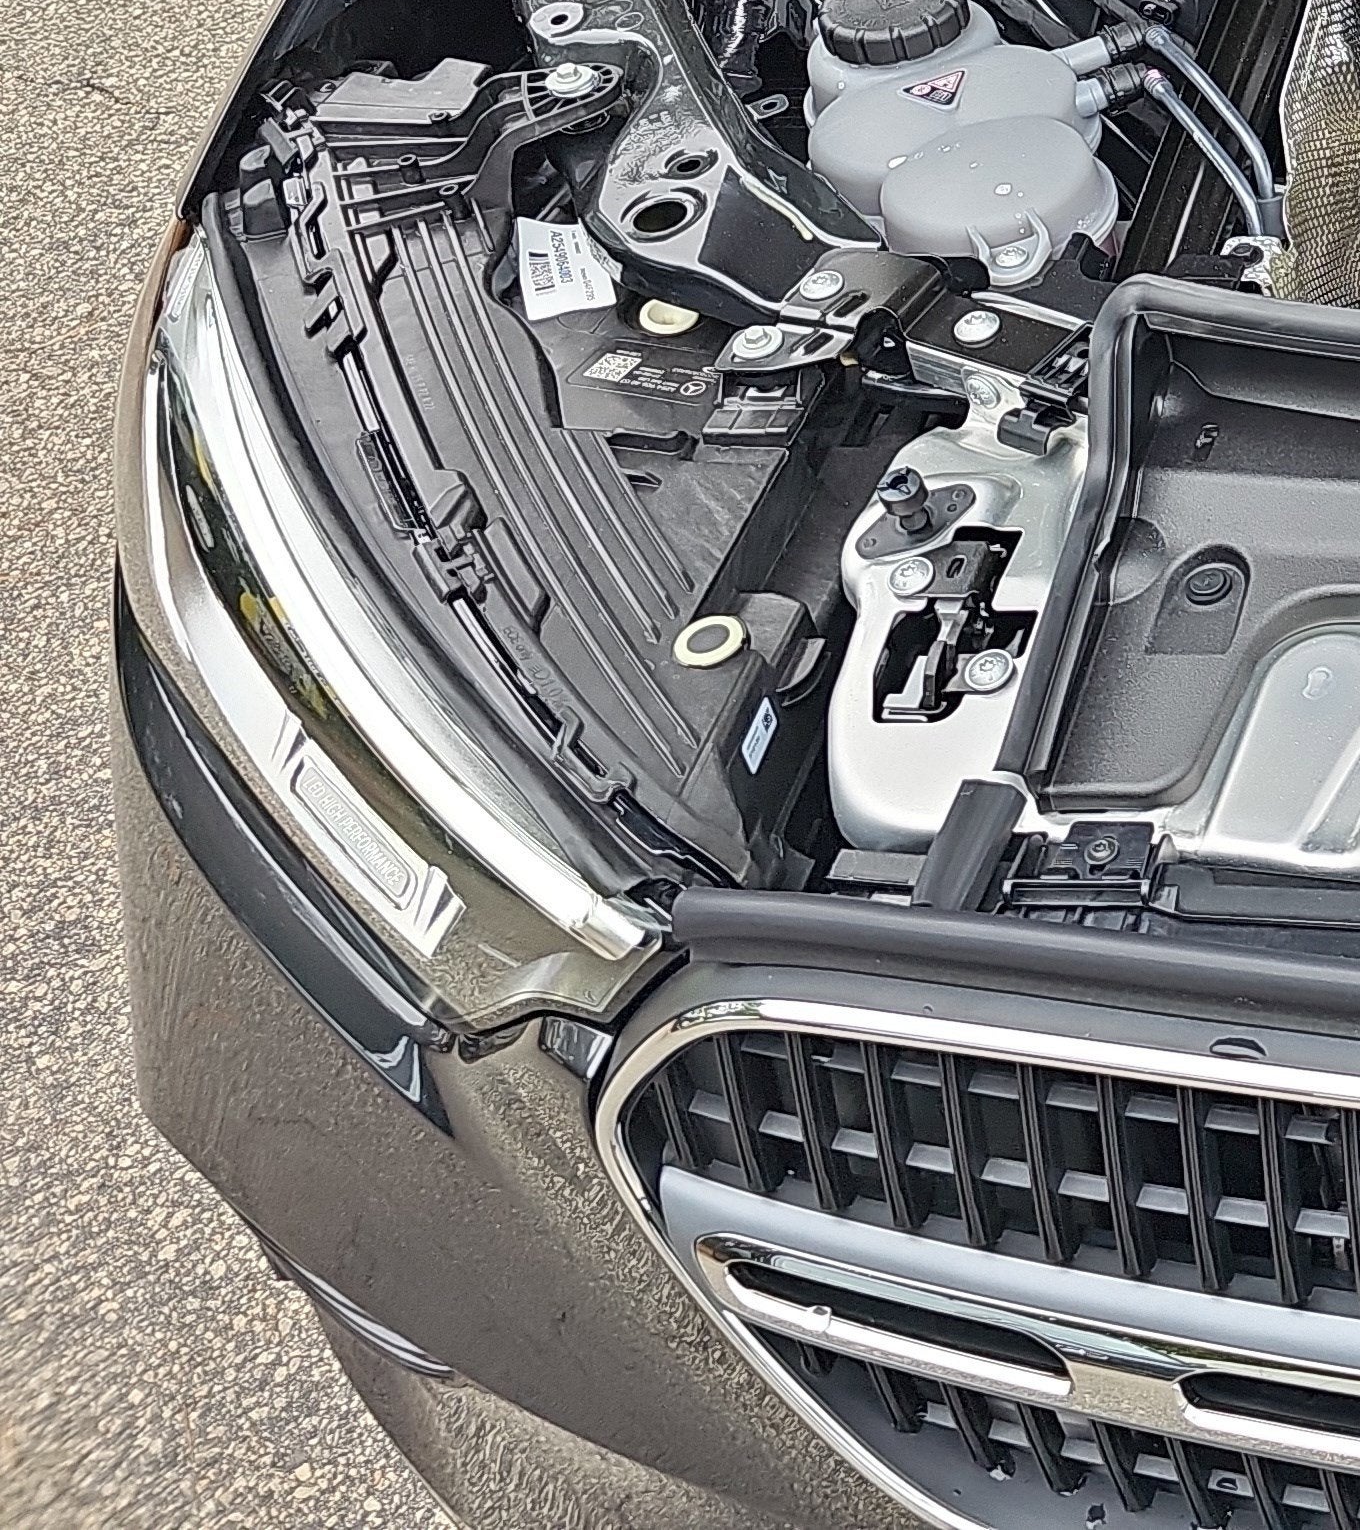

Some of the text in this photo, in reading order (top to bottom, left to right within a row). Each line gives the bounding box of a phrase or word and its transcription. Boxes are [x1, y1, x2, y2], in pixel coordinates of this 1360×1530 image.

[302, 774, 406, 888] LED HIGH PERFORMANCE
